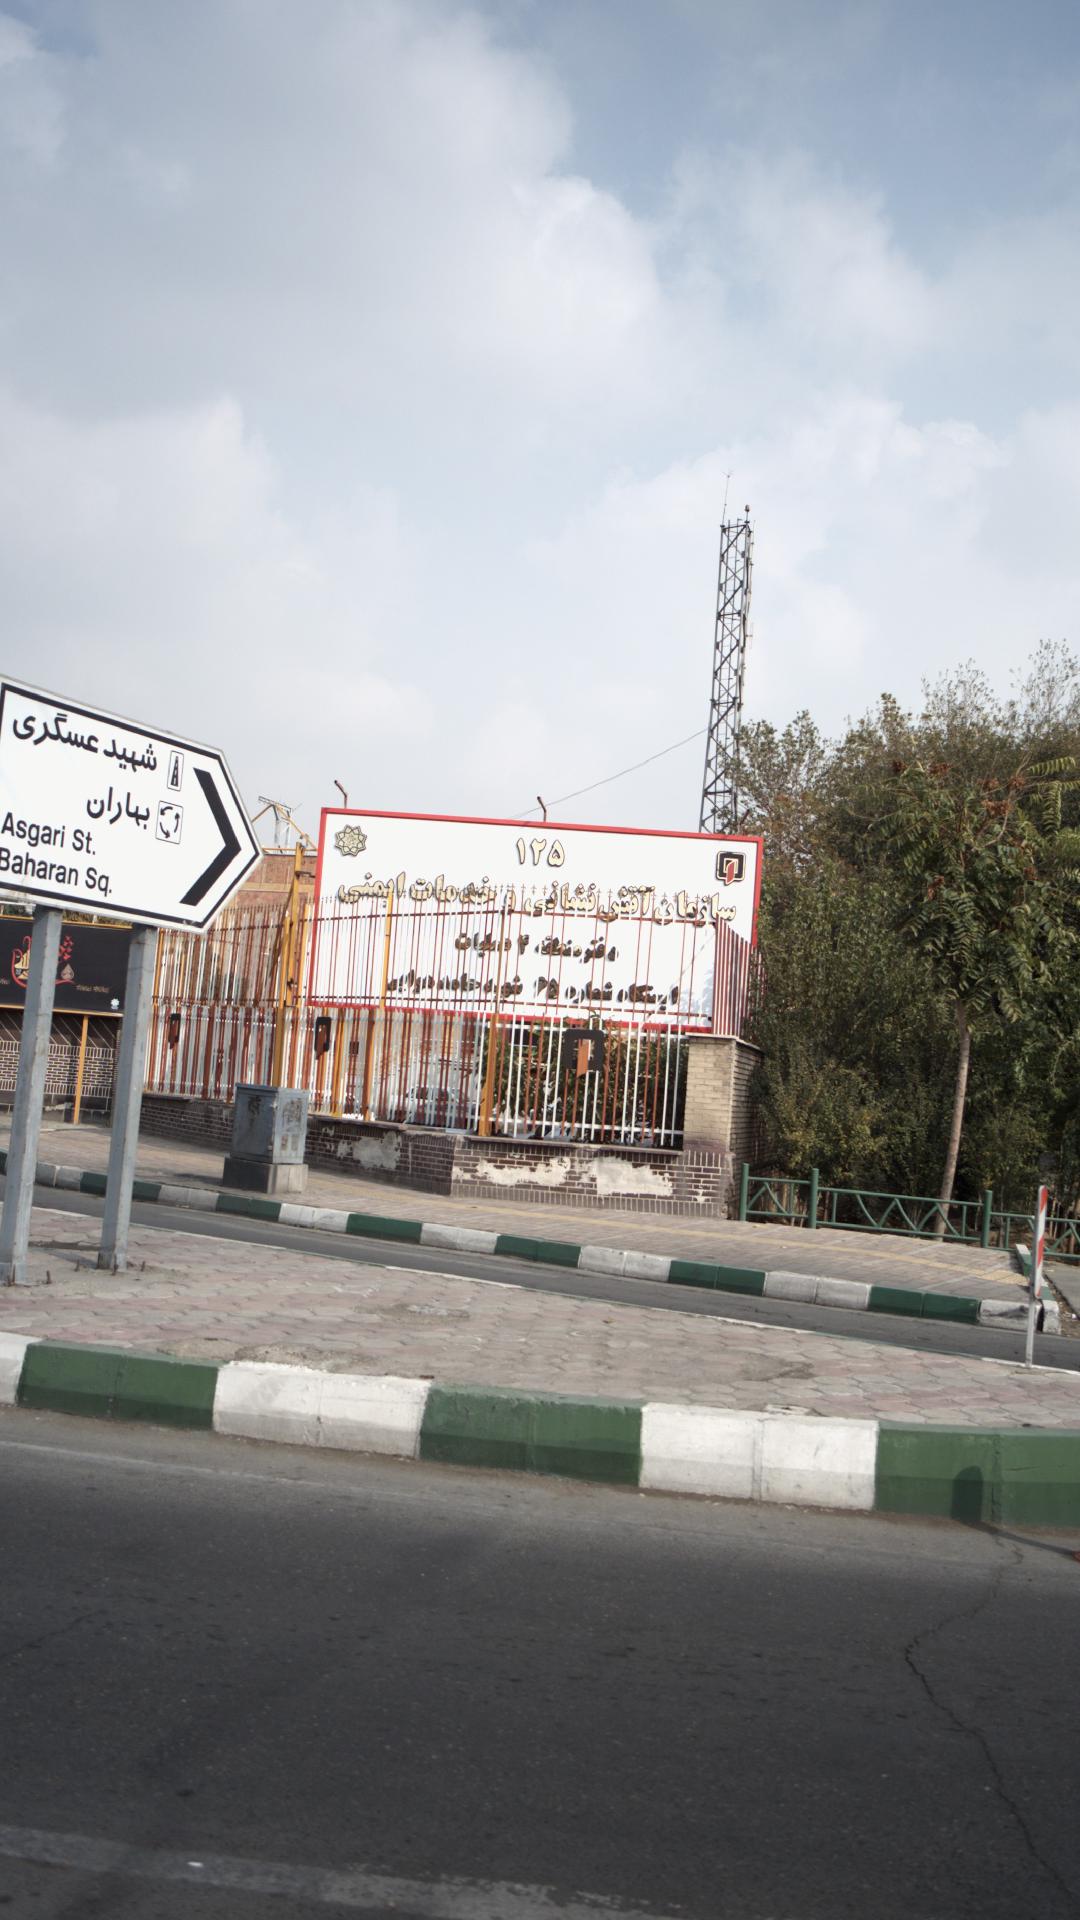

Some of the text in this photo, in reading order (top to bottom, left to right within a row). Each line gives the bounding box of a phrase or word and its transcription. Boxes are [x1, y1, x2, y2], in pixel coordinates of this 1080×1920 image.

[12, 713, 158, 772] شهید عسگری
[86, 786, 150, 830] بهاران
[1, 811, 96, 855] Asgari St.
[515, 837, 565, 868] ۱۲۵
[0, 846, 112, 897] Baharan Sq.
[337, 871, 406, 908] ایمنی
[409, 874, 498, 905] خدمات
[523, 880, 597, 917] نشانی
[599, 886, 655, 923] آتش
[654, 890, 737, 927] سازمان
